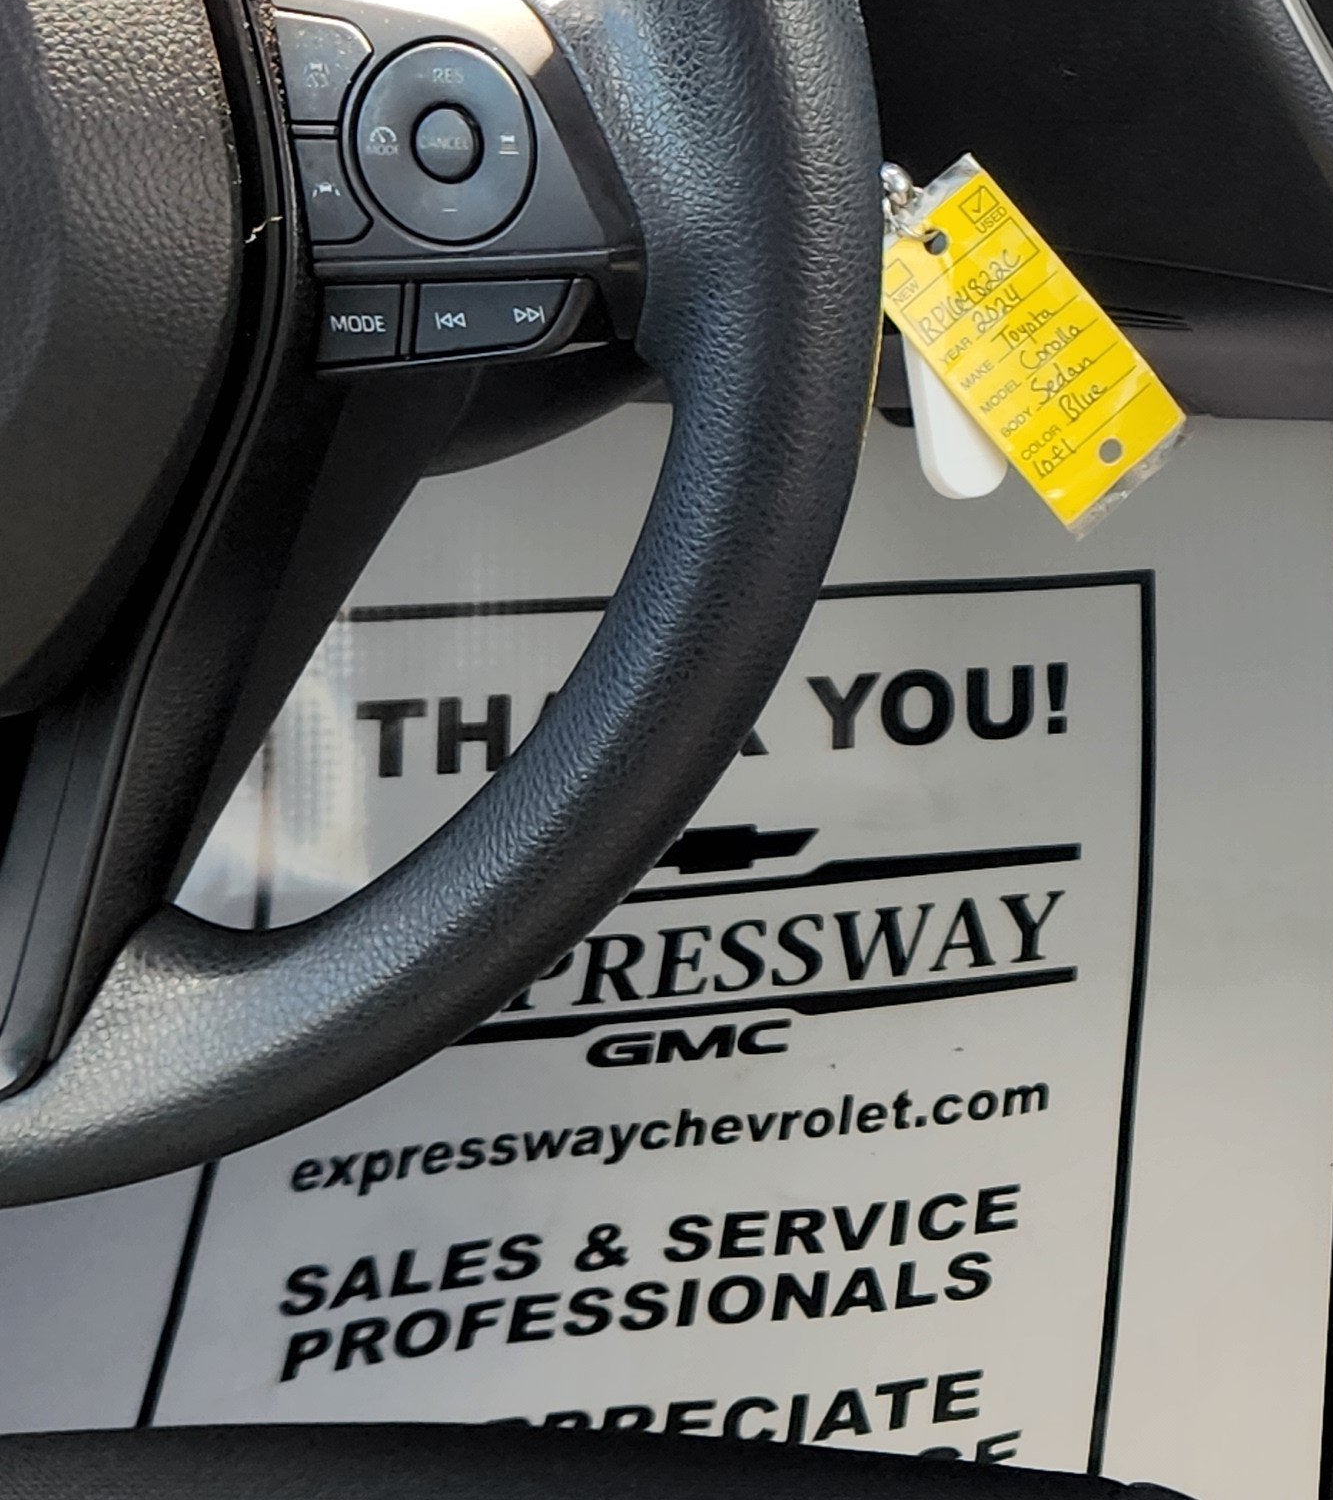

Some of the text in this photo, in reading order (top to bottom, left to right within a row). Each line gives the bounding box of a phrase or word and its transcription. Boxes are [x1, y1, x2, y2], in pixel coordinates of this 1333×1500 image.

[975, 206, 1008, 234] USED
[892, 280, 920, 305] NEW
[330, 315, 386, 334] MODE
[940, 337, 973, 365] YEAR
[960, 359, 994, 391] MAKE
[980, 379, 1022, 414] MODEL
[1000, 407, 1033, 438] BODY
[1021, 424, 1062, 461] COLOR
[806, 662, 1070, 750] YOU!
[586, 1019, 792, 1068] GMC
[291, 1080, 1050, 1197] expresswaychevrolet.com
[280, 1184, 1022, 1318] SALES & SERVICE
[279, 1251, 993, 1382] PROFESSIONALS
